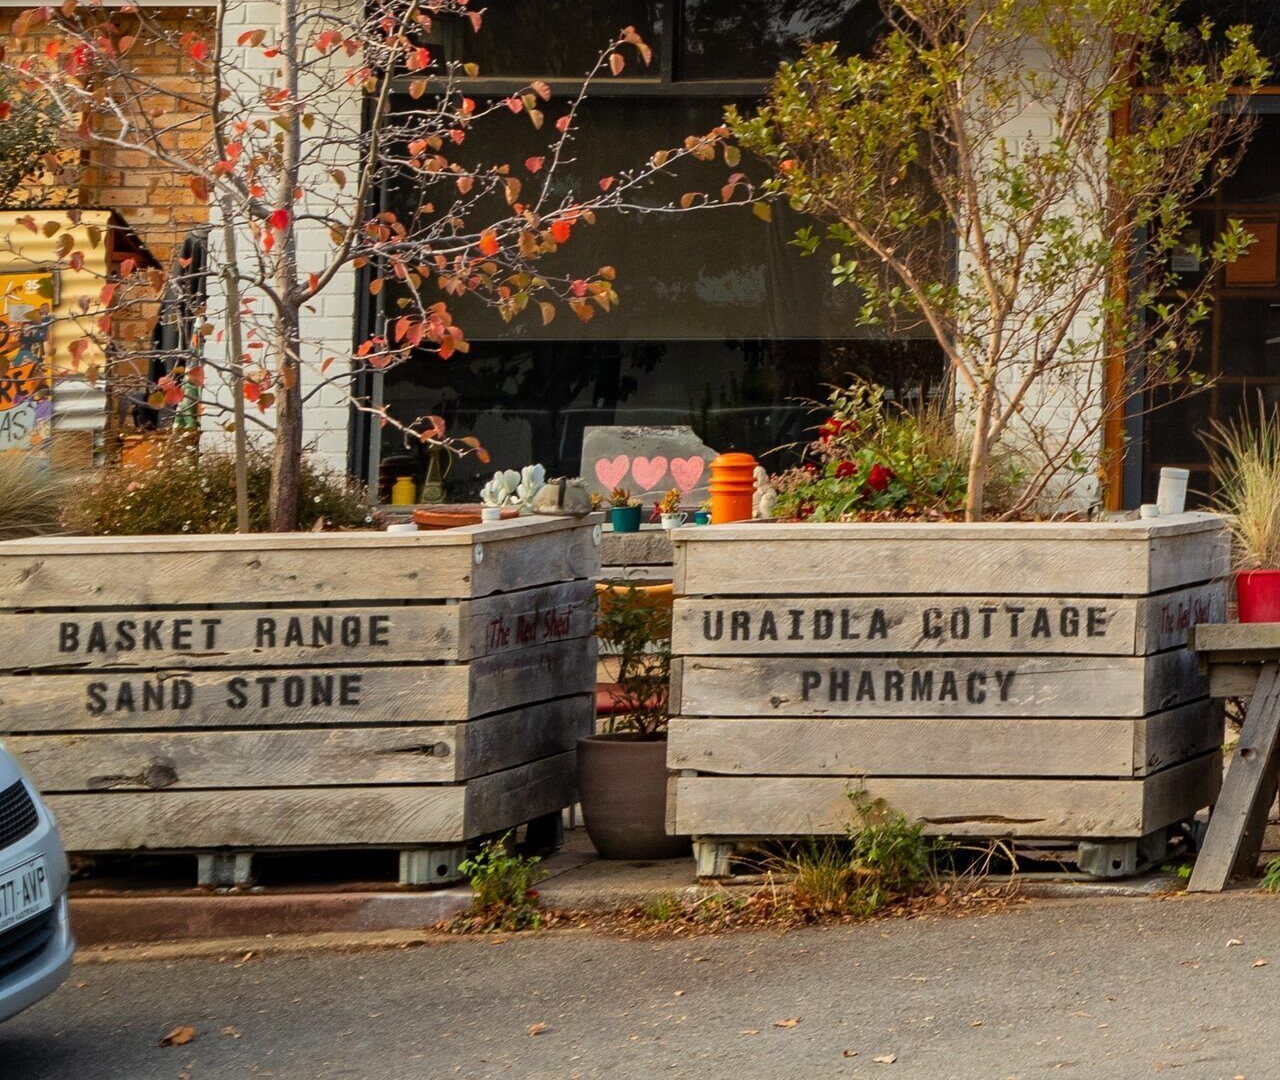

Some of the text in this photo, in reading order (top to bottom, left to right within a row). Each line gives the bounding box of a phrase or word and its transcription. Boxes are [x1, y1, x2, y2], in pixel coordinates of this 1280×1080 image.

[58, 615, 390, 653] BASKET RANGE
[703, 606, 1107, 641] URAIDLA COTTAGE
[86, 675, 363, 716] SAND STONE
[802, 670, 1016, 704] PHARMACY
